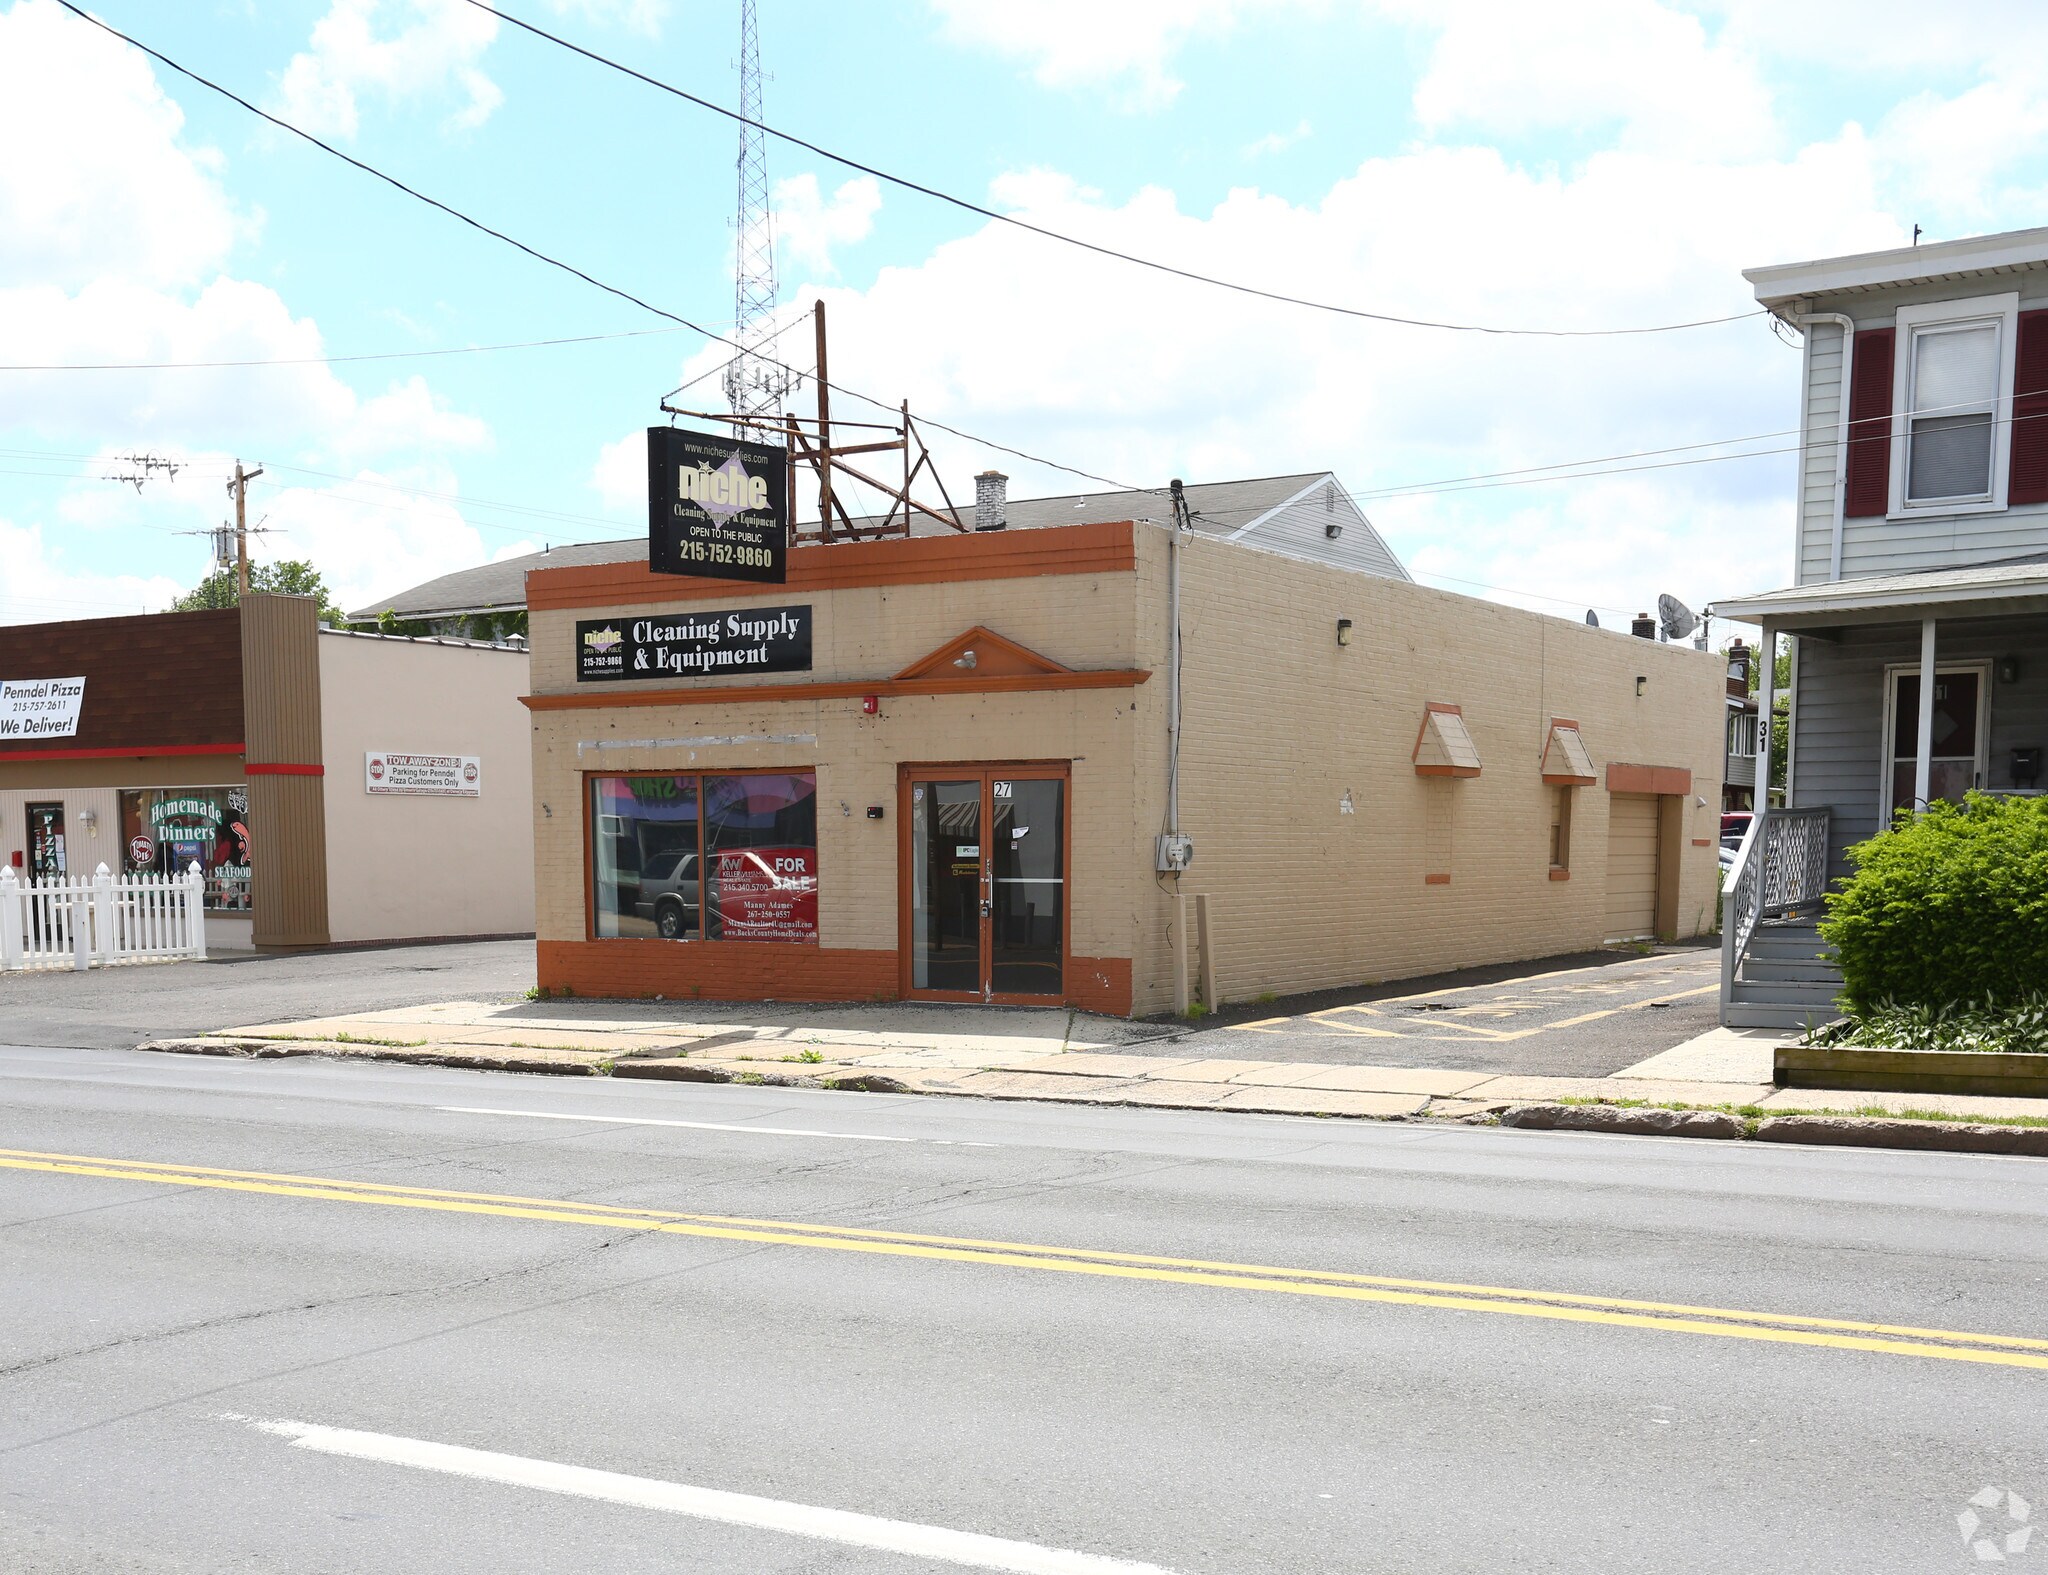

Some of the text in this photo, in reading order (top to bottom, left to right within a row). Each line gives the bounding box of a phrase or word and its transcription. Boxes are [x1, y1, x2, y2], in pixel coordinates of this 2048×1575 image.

[685, 443, 768, 464] www.nichesupplies.com
[679, 463, 767, 510] niche
[674, 504, 777, 528] Cleaning Supply & Equipment
[690, 526, 762, 543] OPEN TO THE PUBLIC
[633, 611, 800, 644] Cleaning Supply
[584, 630, 622, 645] niche
[633, 643, 769, 673] & Equipment
[3, 683, 81, 699] Penndel Pizza
[13, 700, 66, 712] 215-757-2611
[1, 716, 73, 734] We Deliver!
[1759, 721, 1767, 752] 31
[388, 755, 407, 765] TOW
[407, 757, 431, 767] AWAY
[370, 765, 384, 774] STOP
[392, 768, 456, 777] Parking for Penndel
[389, 776, 459, 788] Pizza Customers Only
[994, 782, 1011, 797] 27
[151, 799, 222, 824] Homemade
[159, 825, 215, 841] Dinners
[43, 815, 55, 867] PIZZA
[136, 850, 149, 861] PIE
[215, 866, 251, 878] SEAFOOD
[776, 858, 806, 872] FOR
[773, 876, 810, 890] SALE
[744, 901, 793, 910] Manny Adames
